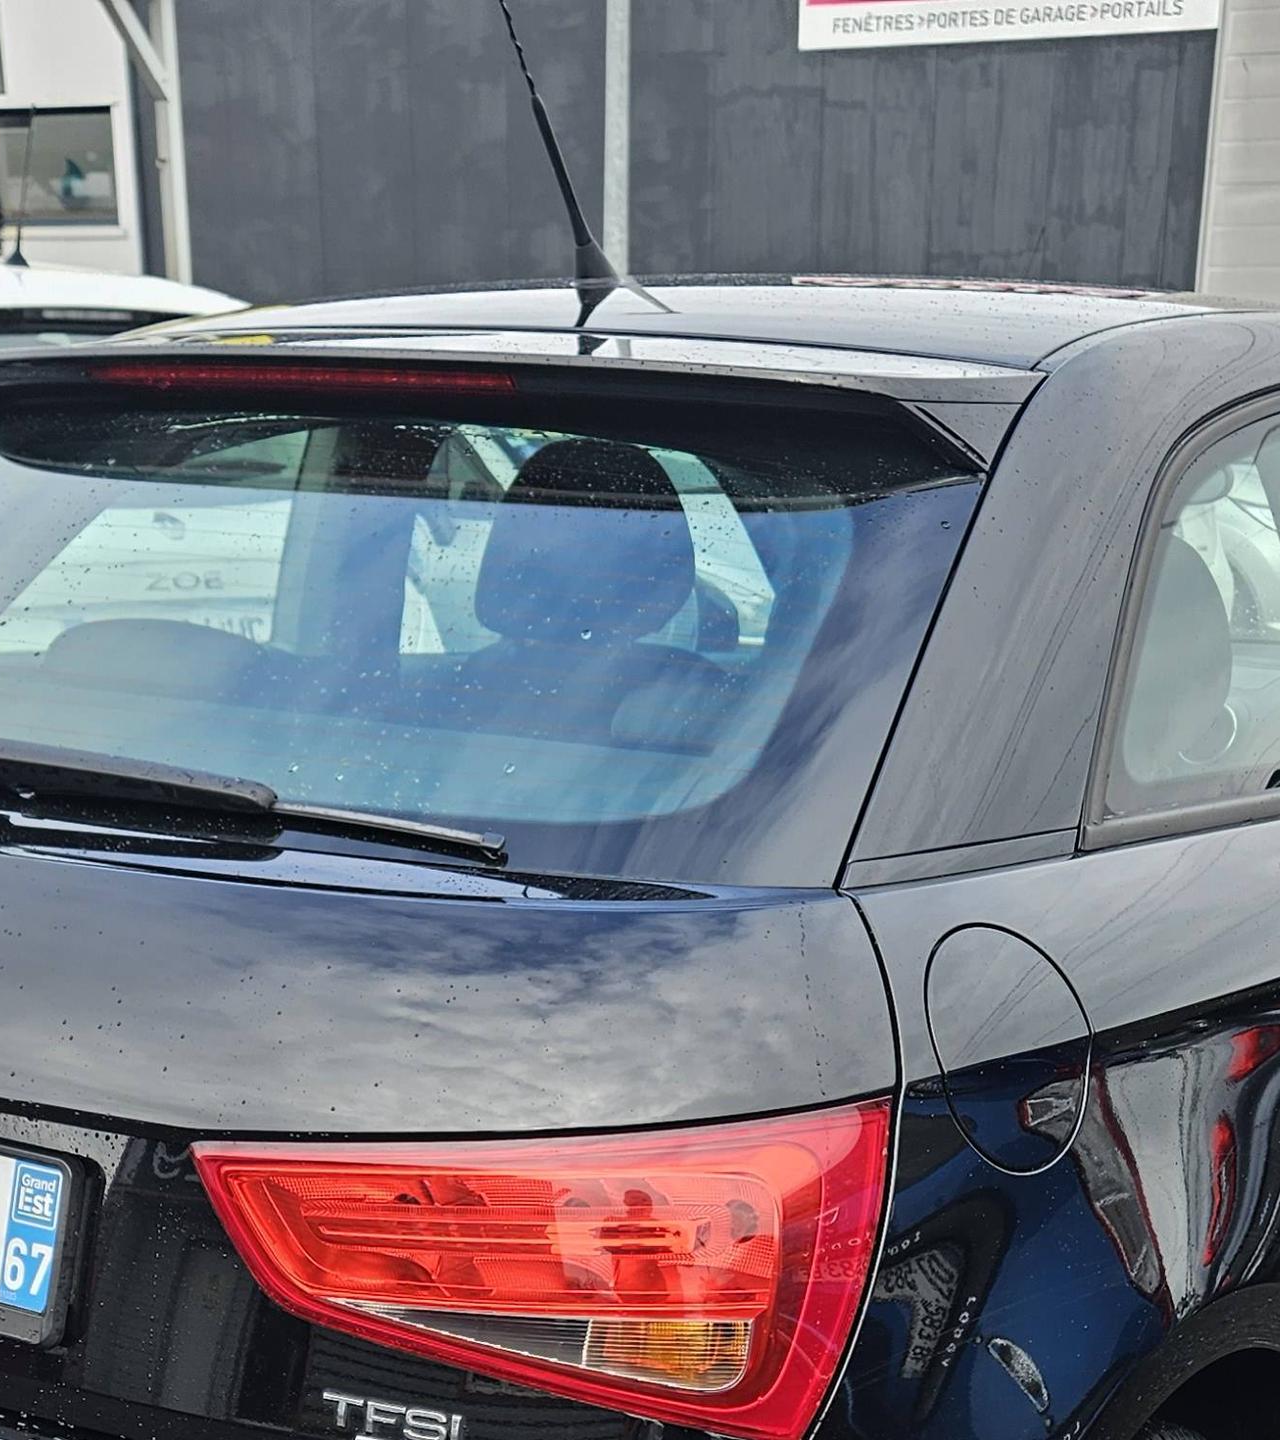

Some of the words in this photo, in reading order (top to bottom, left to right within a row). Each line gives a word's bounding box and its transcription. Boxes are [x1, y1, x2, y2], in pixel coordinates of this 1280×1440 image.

[994, 8, 1018, 26] DE
[21, 1173, 57, 1192] Grand
[18, 1189, 54, 1217] Est
[3, 1237, 54, 1296] 67
